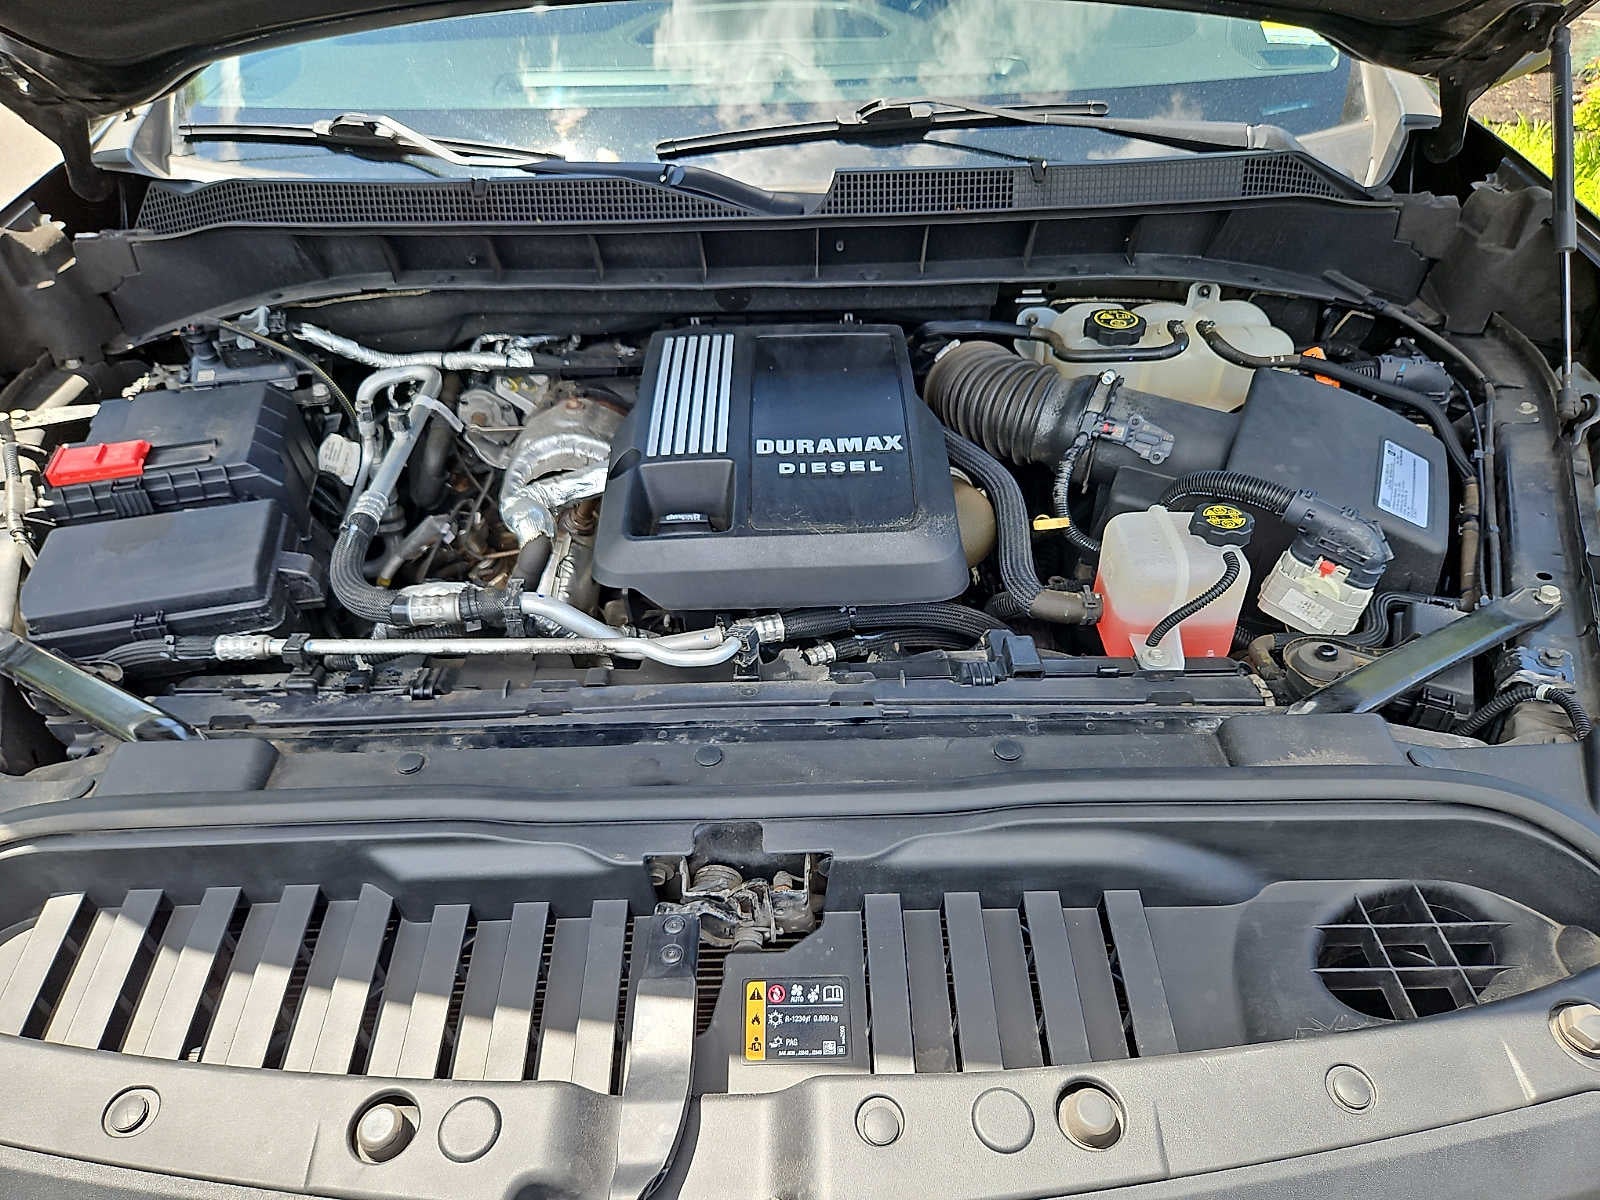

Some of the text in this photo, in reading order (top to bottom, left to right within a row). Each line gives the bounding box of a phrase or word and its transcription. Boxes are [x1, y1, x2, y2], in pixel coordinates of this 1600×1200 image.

[756, 435, 904, 454] DURAMAX
[778, 460, 883, 474] DIESEL
[830, 1015, 839, 1023] kg
[785, 1038, 798, 1046] PAG
